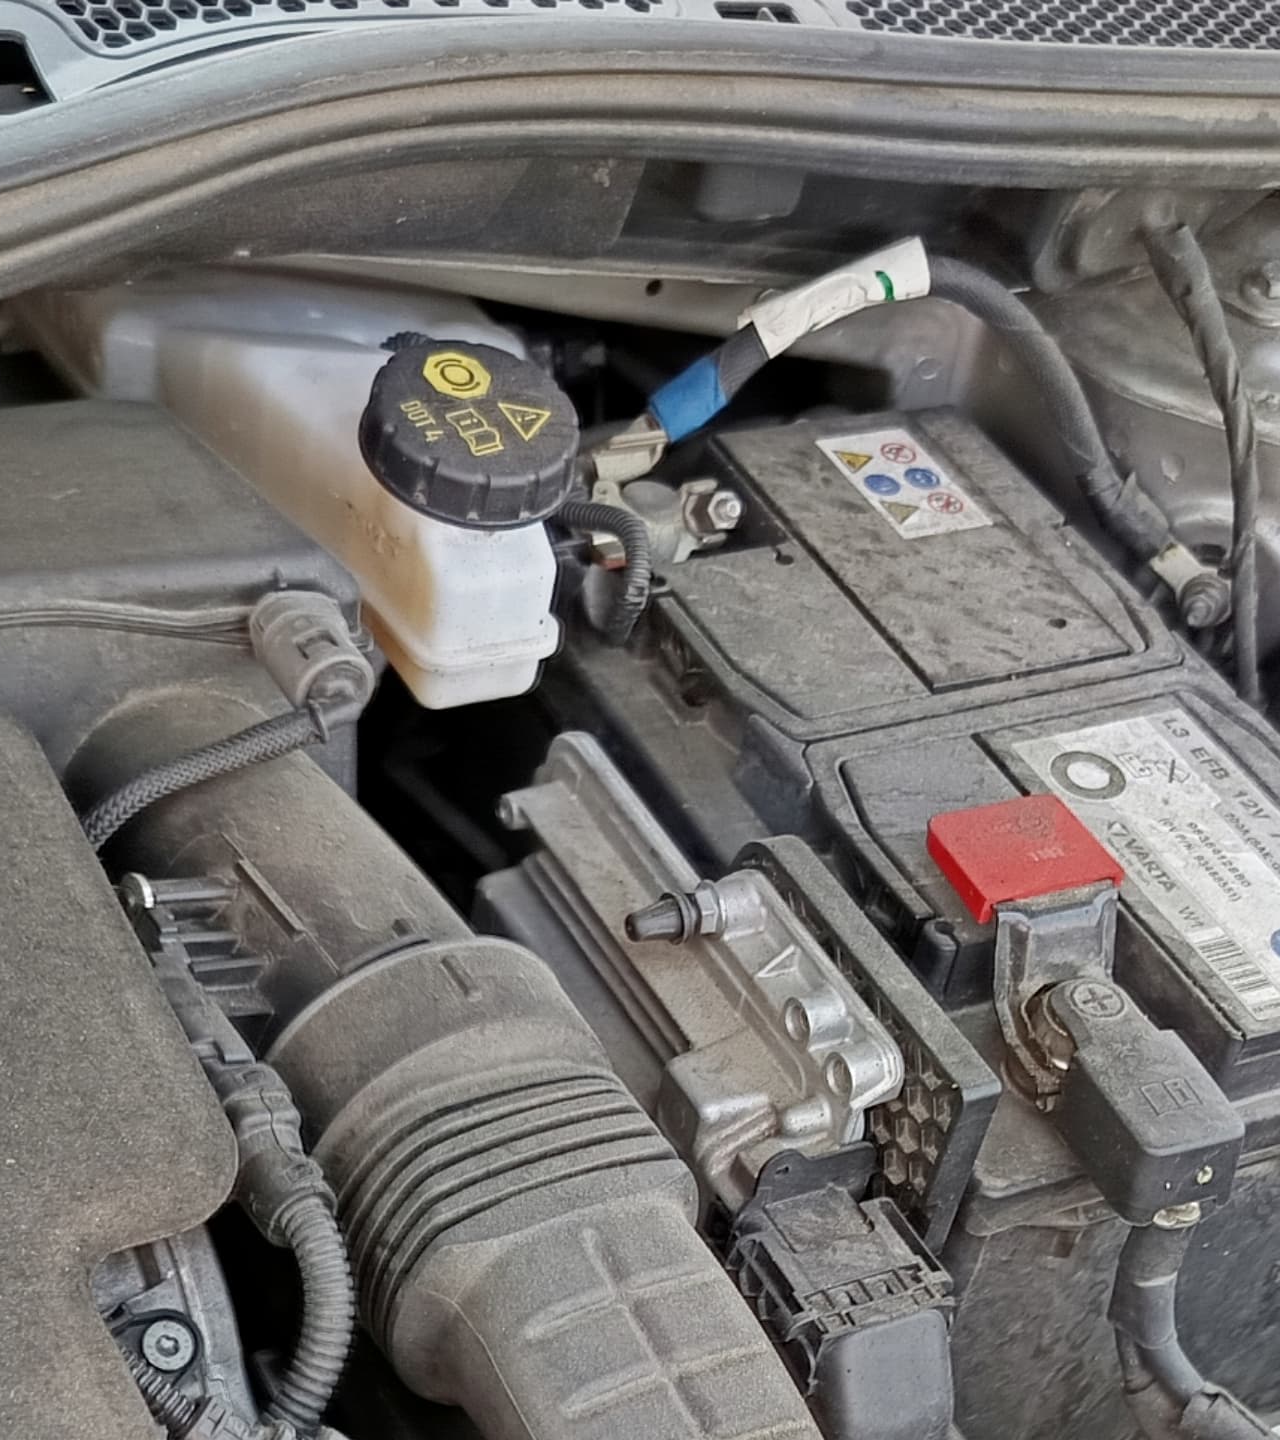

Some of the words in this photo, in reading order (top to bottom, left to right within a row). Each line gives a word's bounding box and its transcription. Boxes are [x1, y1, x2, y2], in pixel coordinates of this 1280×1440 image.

[401, 399, 436, 429] DOT
[424, 429, 444, 442] 4
[1189, 747, 1230, 781] EFB
[1230, 790, 1269, 820] 12V
[1121, 837, 1178, 893] VARTA
